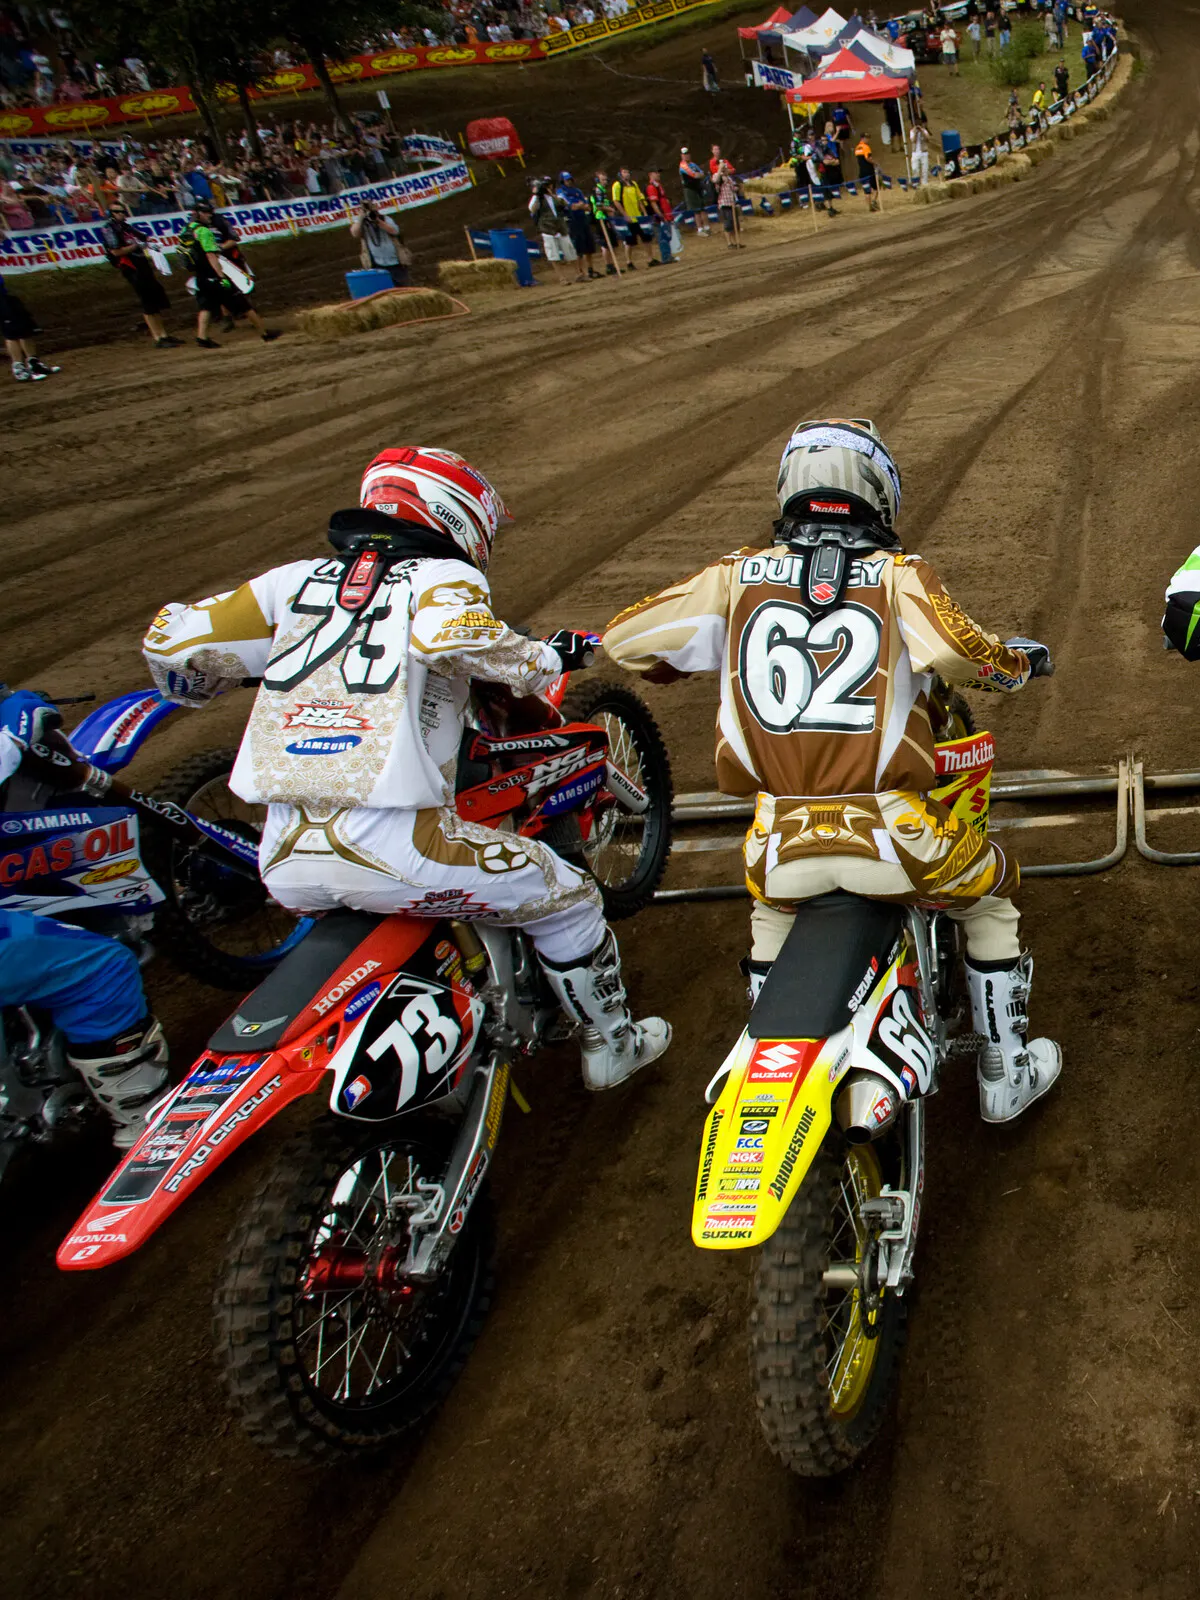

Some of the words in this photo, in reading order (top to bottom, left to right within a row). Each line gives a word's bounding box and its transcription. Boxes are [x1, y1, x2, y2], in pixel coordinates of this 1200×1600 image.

[758, 60, 795, 89] PARTS
[234, 203, 306, 226] PARTS
[306, 192, 361, 219] PARTS
[404, 170, 447, 195] PARTS
[378, 504, 394, 512] DOT
[433, 503, 465, 532] SHOEI
[740, 555, 888, 588] DUEY
[738, 598, 885, 735] 62
[296, 738, 354, 751] SAMSUNG
[489, 738, 555, 752] HONDA
[549, 775, 603, 806] SAMSUNG
[611, 770, 645, 803] DUNLOP
[21, 811, 93, 831] YAMAHA
[83, 819, 136, 861] OIL
[312, 958, 382, 1016] HONDA
[345, 985, 381, 1017] SAMSUNG
[847, 966, 876, 1012] SUZUKI
[366, 994, 462, 1112] 73
[878, 988, 933, 1095] 62
[751, 1071, 793, 1079] SUZUKI
[163, 1146, 213, 1193] PRO
[207, 1074, 282, 1147] CIRCUIT
[736, 1138, 764, 1149] F.C.C.
[697, 1110, 725, 1201] BRIDGESTONE
[731, 1153, 761, 1163] NGK
[769, 1104, 817, 1202] BRIDGESTONE
[714, 1193, 759, 1201] Snap-on
[67, 1232, 128, 1245] HONDA
[702, 1230, 753, 1239] SUZUKI
